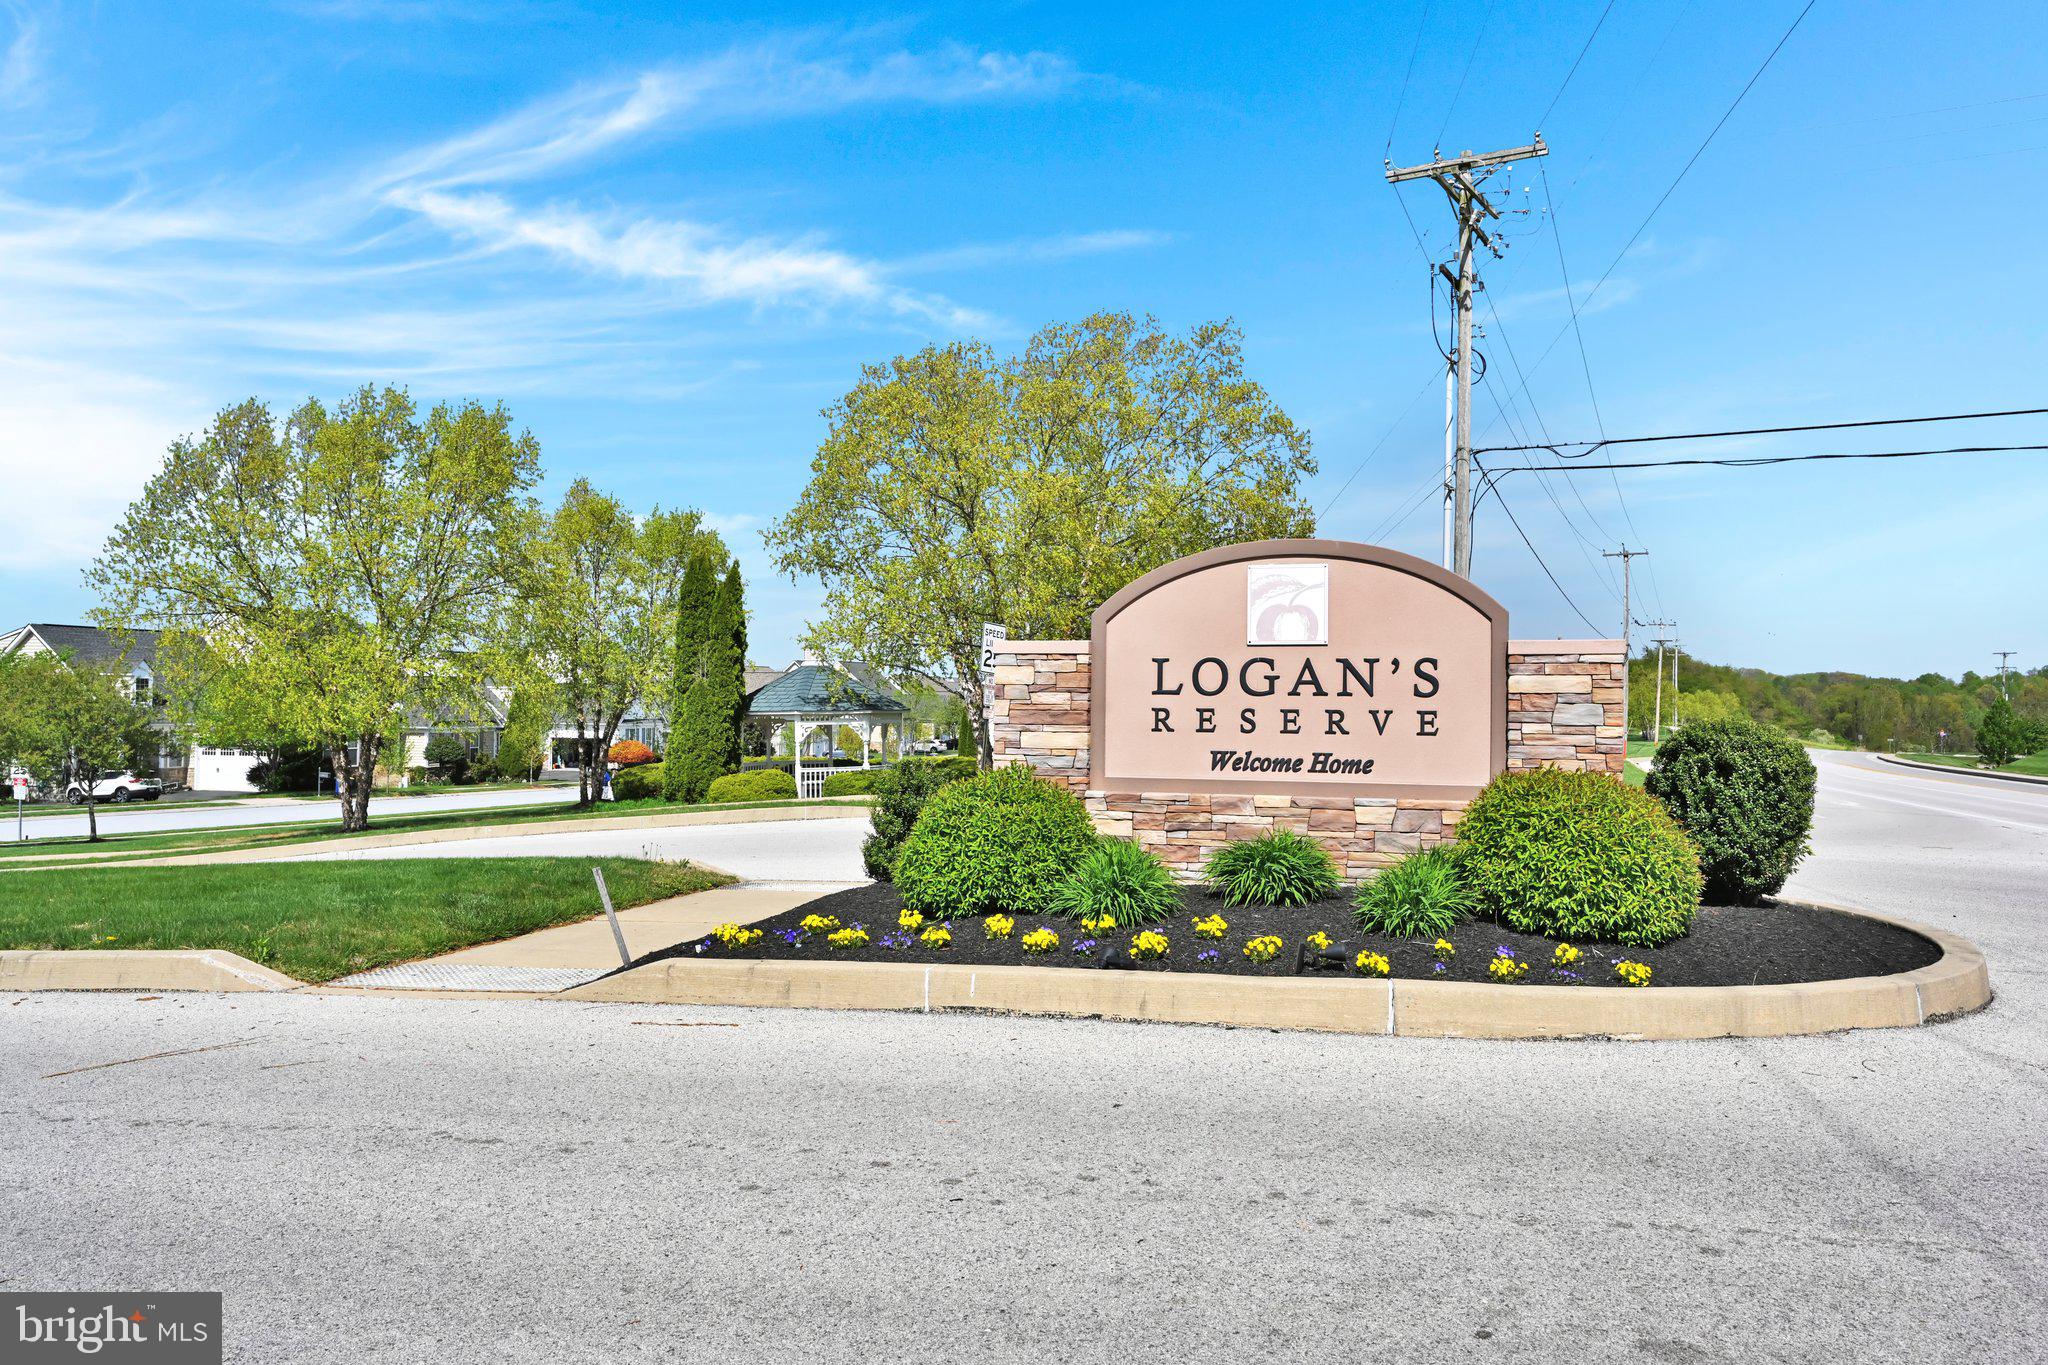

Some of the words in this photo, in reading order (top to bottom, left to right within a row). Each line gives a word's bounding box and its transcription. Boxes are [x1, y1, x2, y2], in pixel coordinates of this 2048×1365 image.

[985, 628, 1005, 640] SPEED
[1151, 657, 1440, 699] LOGAN'S
[1151, 707, 1440, 737] RESERVE
[1210, 750, 1303, 774] Welcome
[1307, 752, 1375, 775] Home
